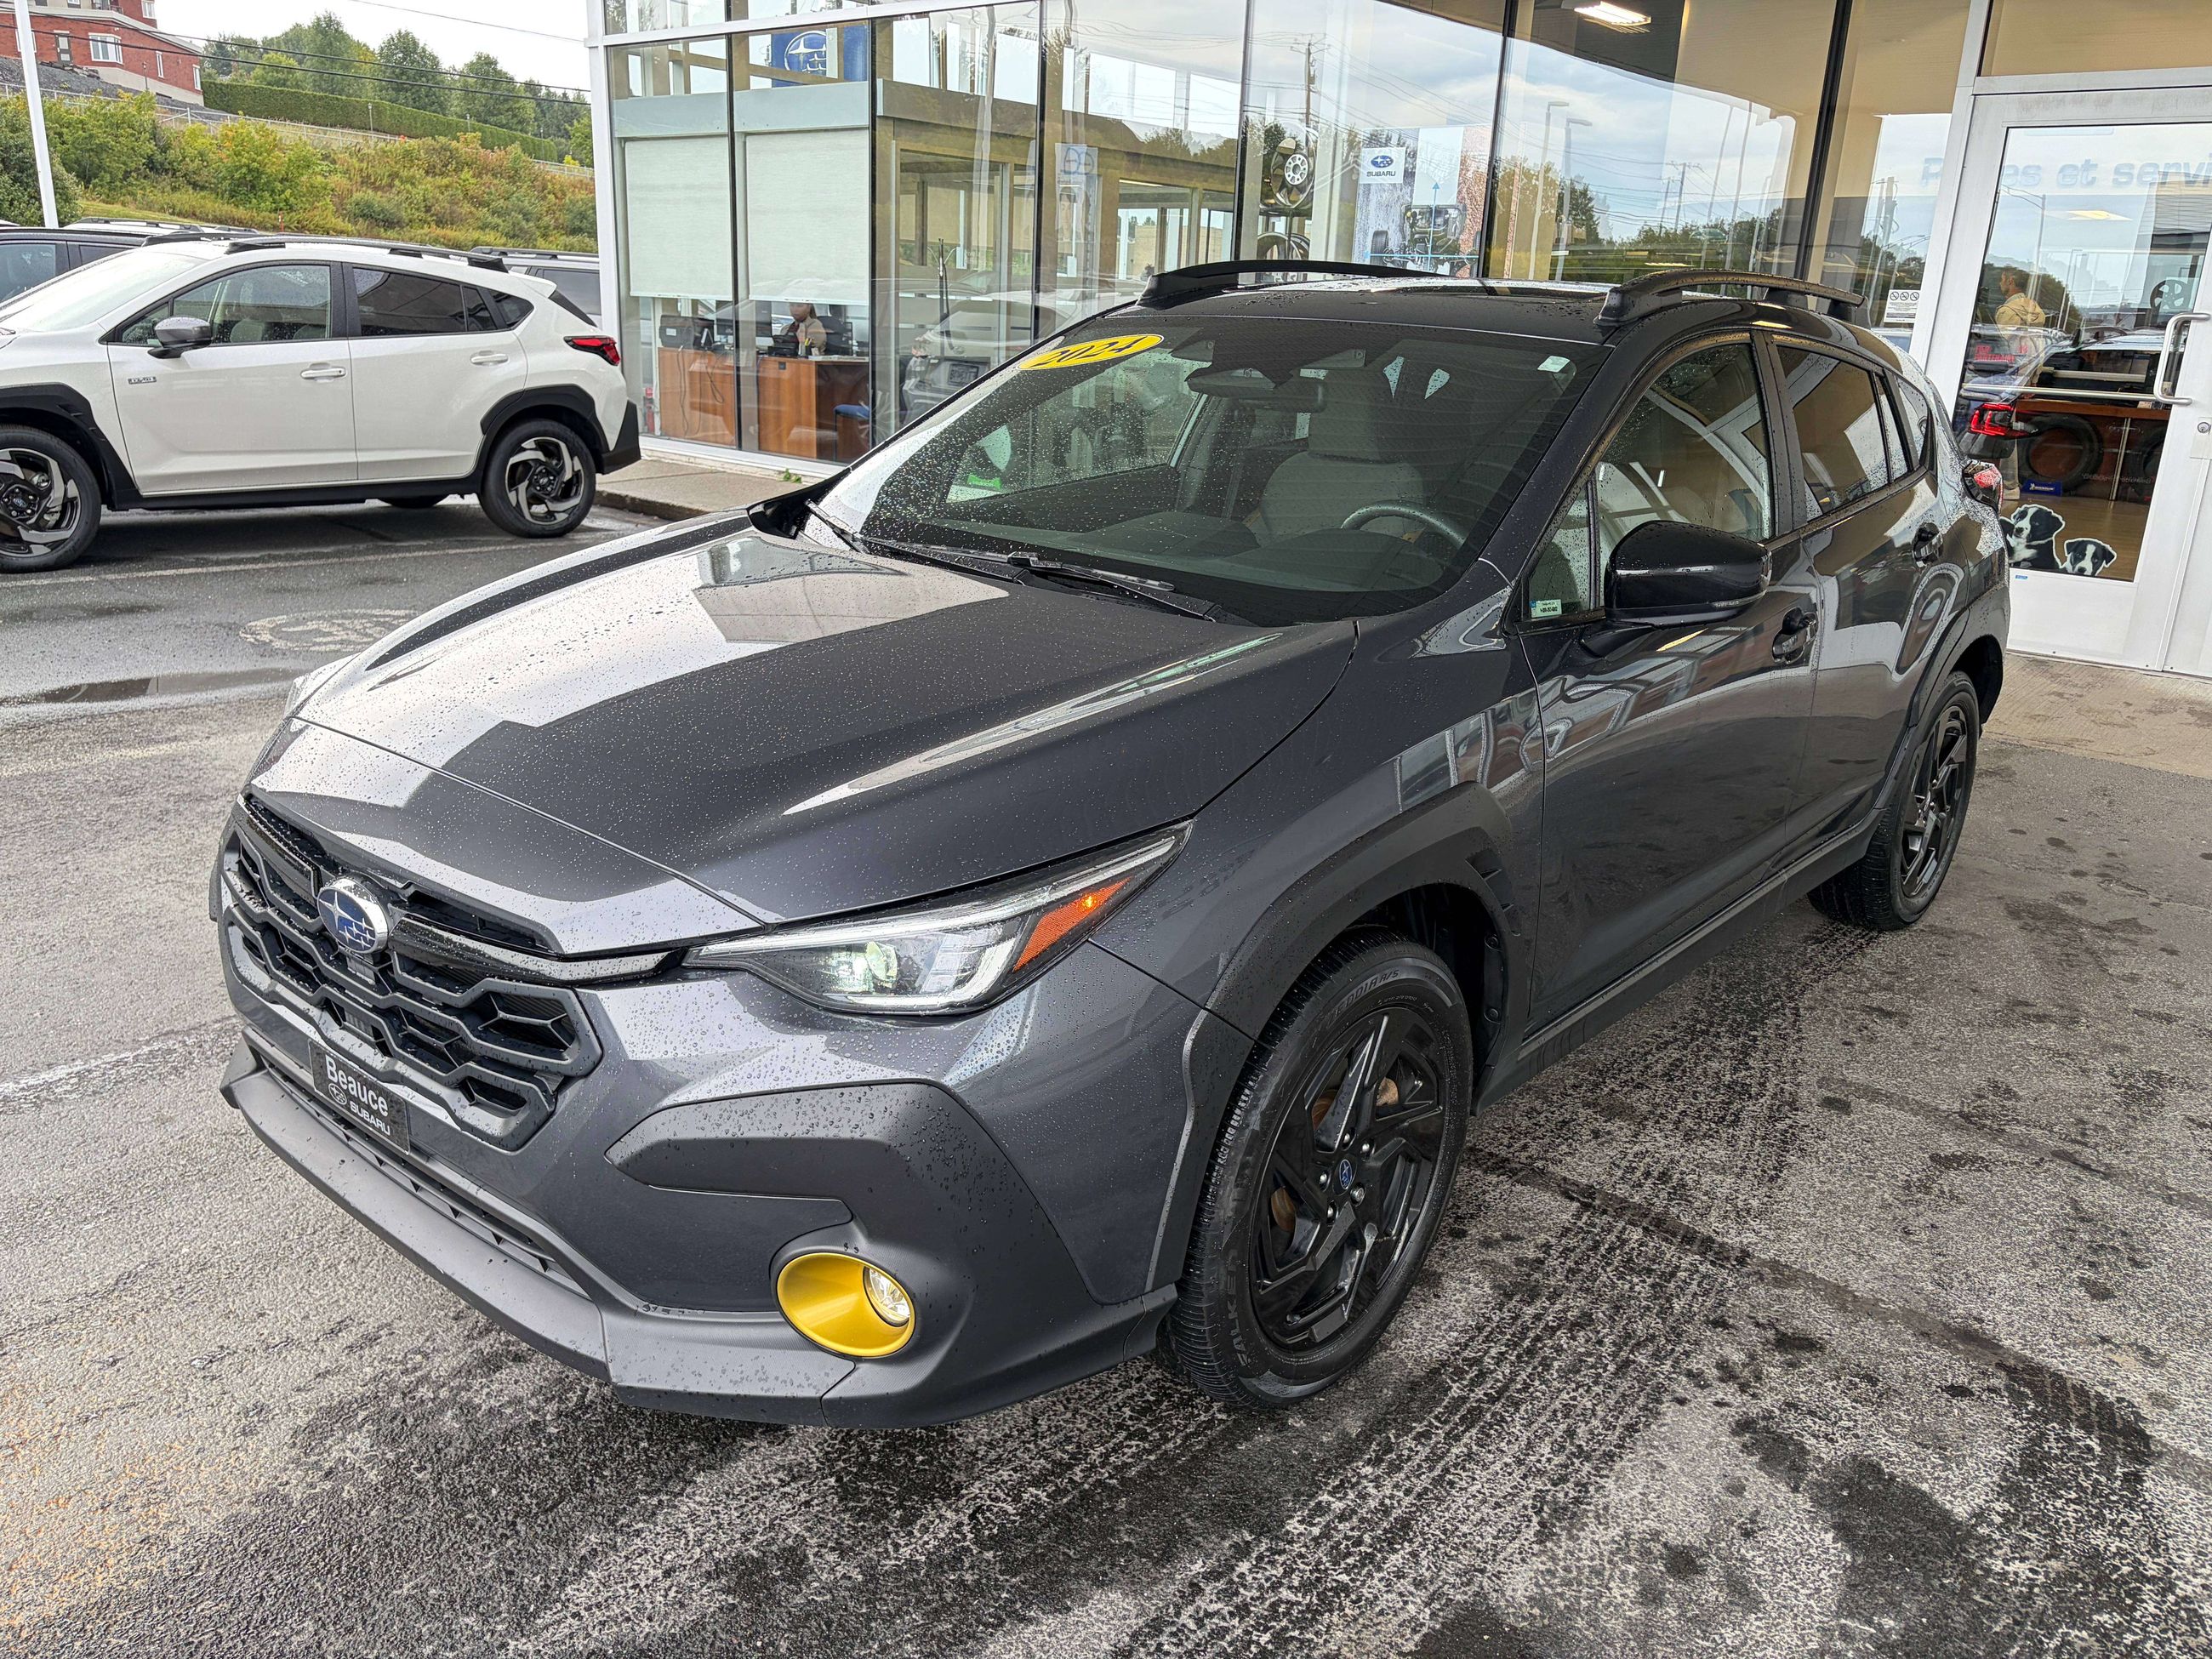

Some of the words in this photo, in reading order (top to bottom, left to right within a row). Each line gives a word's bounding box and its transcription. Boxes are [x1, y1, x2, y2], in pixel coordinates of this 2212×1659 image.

[2056, 159, 2098, 187] et
[1029, 335, 1149, 368] 2024
[325, 1054, 389, 1117] Beauce
[350, 1100, 391, 1136] SUBARU
